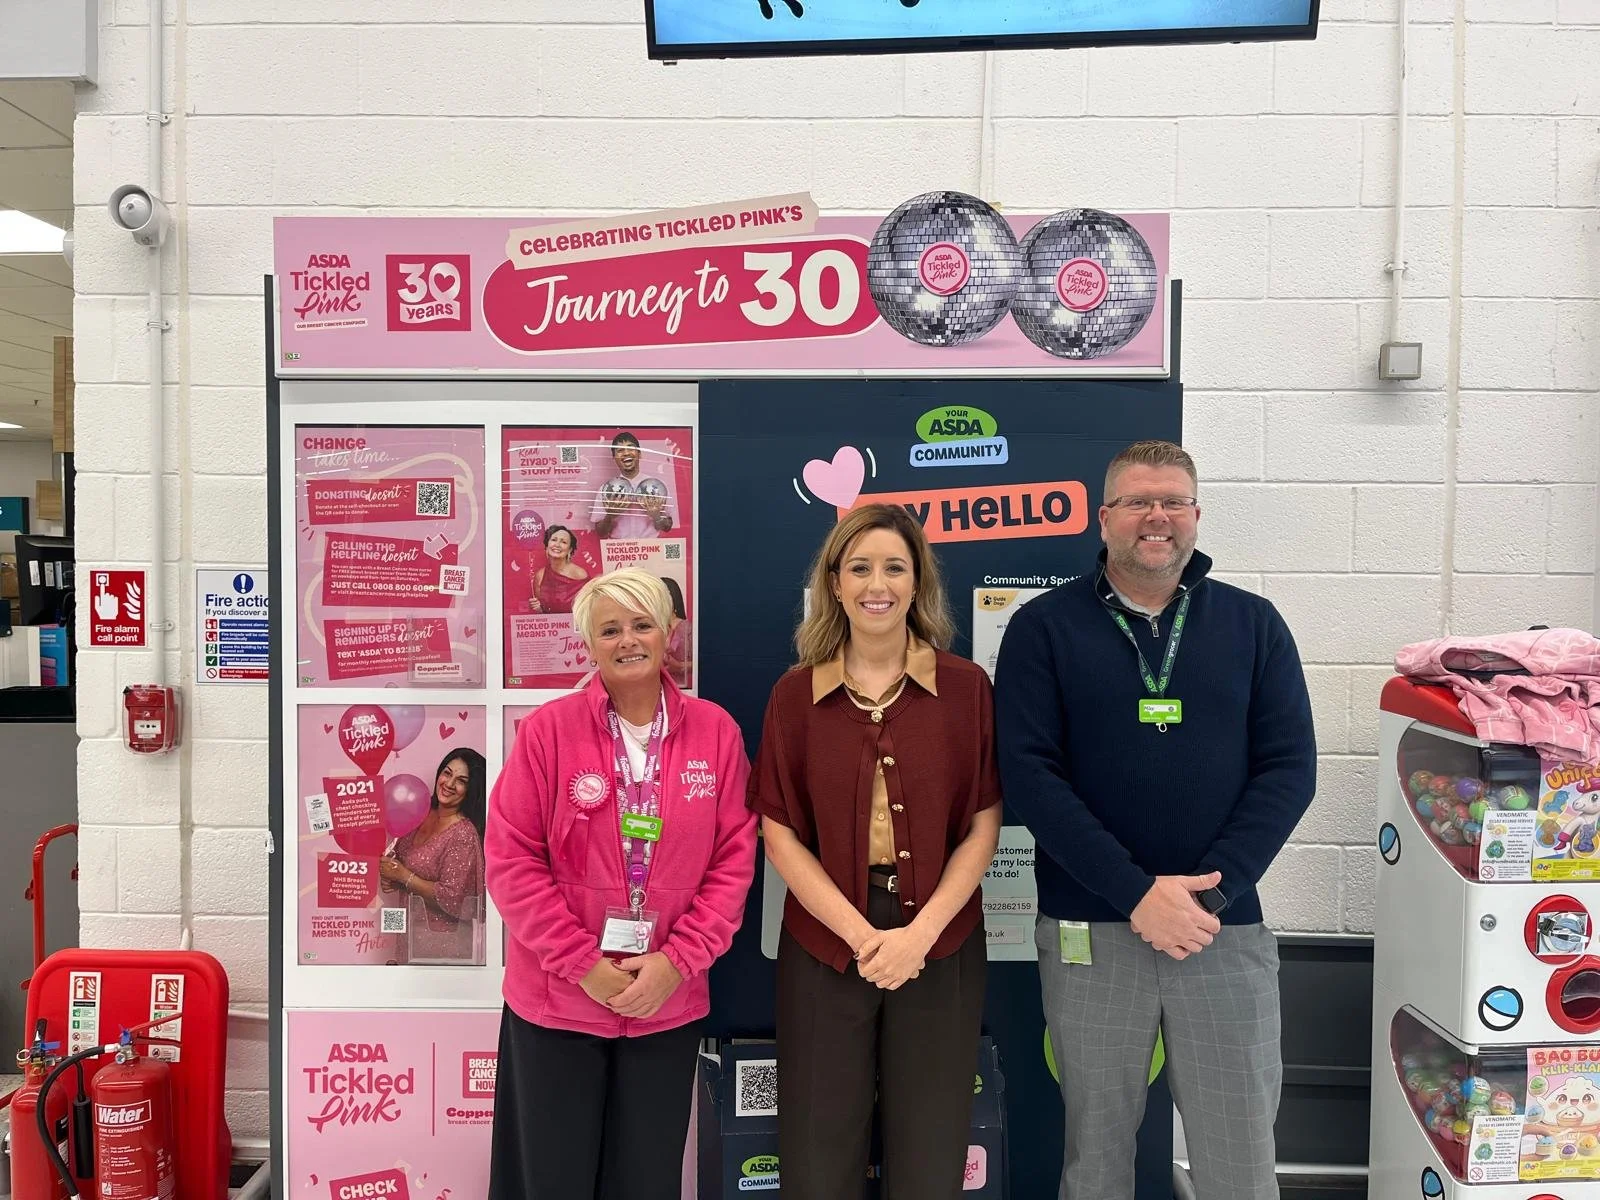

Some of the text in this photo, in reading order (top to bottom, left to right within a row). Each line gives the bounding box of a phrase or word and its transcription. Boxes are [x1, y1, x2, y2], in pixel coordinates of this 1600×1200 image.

[739, 205, 803, 228] PINK'S
[307, 254, 351, 268] ASDA
[934, 254, 953, 262] ASDA
[927, 260, 961, 272] Tickled
[1075, 268, 1093, 278] ASDA
[289, 270, 370, 291] Tickled
[397, 261, 461, 303] 30
[1066, 274, 1100, 289] Tickled
[523, 249, 861, 336] Journey to 30
[293, 286, 362, 321] Pink
[946, 409, 969, 418] YOUR
[929, 419, 985, 437] ASDA
[914, 443, 1003, 462] COMMUNITY
[514, 522, 543, 531] Tickled
[331, 581, 351, 589] JUST
[373, 583, 393, 591] 0808
[983, 575, 1048, 587] Community
[205, 594, 233, 607] Fire
[228, 608, 261, 616] discover
[95, 624, 140, 633] Fire alarm
[334, 623, 408, 637] SIGNING UP FO
[548, 629, 559, 637] TO
[96, 634, 138, 643] call point
[384, 647, 395, 655] TO
[351, 714, 378, 726] ASDA
[342, 722, 390, 741] Tickled
[348, 733, 386, 757] Pink
[687, 760, 709, 770] ASDA
[336, 780, 375, 797] 2021
[994, 847, 1034, 855] ustomer
[328, 860, 368, 875] 2023
[1000, 860, 1015, 870] my
[1016, 858, 1036, 867] loca
[992, 870, 1003, 878] to
[1004, 869, 1020, 878] do!
[983, 903, 1032, 911] 7922862159
[352, 920, 375, 928] PINK
[348, 929, 360, 937] TO
[987, 929, 1005, 938] a.uk
[328, 1043, 388, 1063] ASDA
[1534, 1048, 1600, 1066] BAO BU
[469, 1058, 497, 1069] BREAS
[469, 1068, 497, 1079] CANCE
[303, 1065, 414, 1095] Tickled
[98, 1107, 145, 1124] Water
[307, 1087, 402, 1134] Pink
[446, 1107, 493, 1119] Coppa
[741, 1177, 780, 1187] COMMUN
